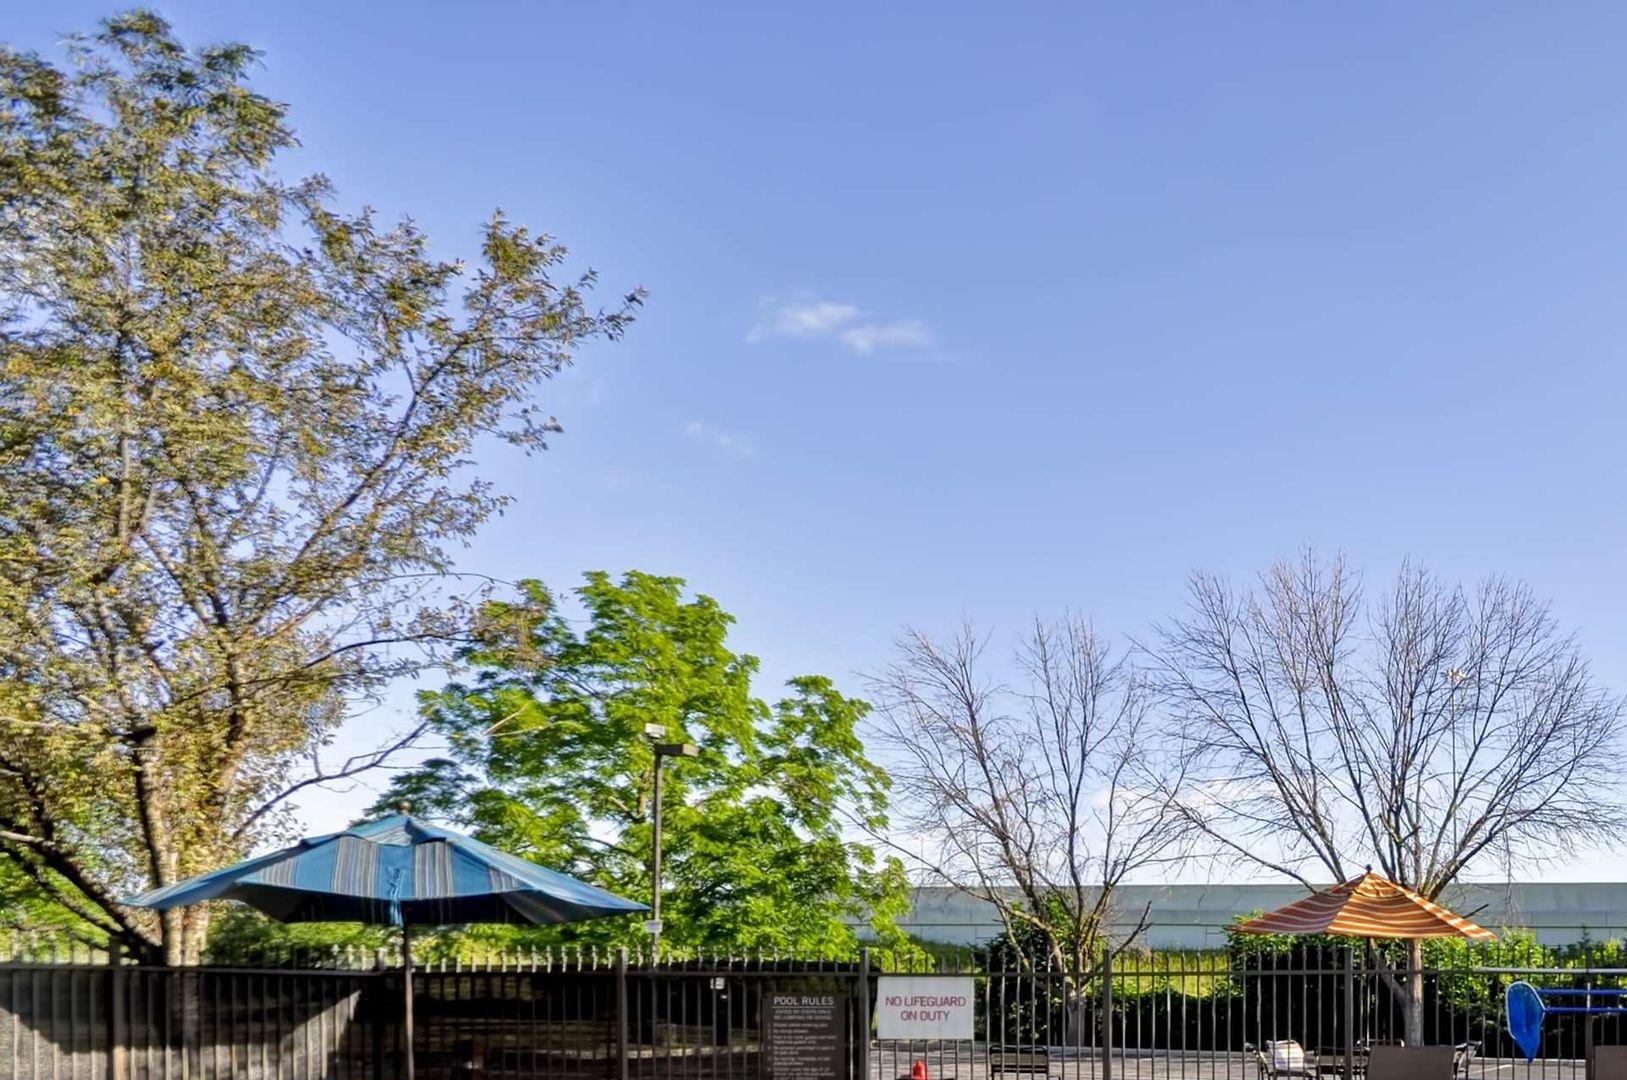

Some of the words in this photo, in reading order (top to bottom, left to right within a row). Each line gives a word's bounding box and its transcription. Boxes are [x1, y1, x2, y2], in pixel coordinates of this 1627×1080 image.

[773, 996, 800, 1006] POOL
[801, 996, 834, 1006] RULES
[885, 996, 902, 1007] NO
[904, 996, 967, 1007] LIFEGUARD
[901, 1011, 917, 1022] ON
[920, 1011, 951, 1022] DUTY
